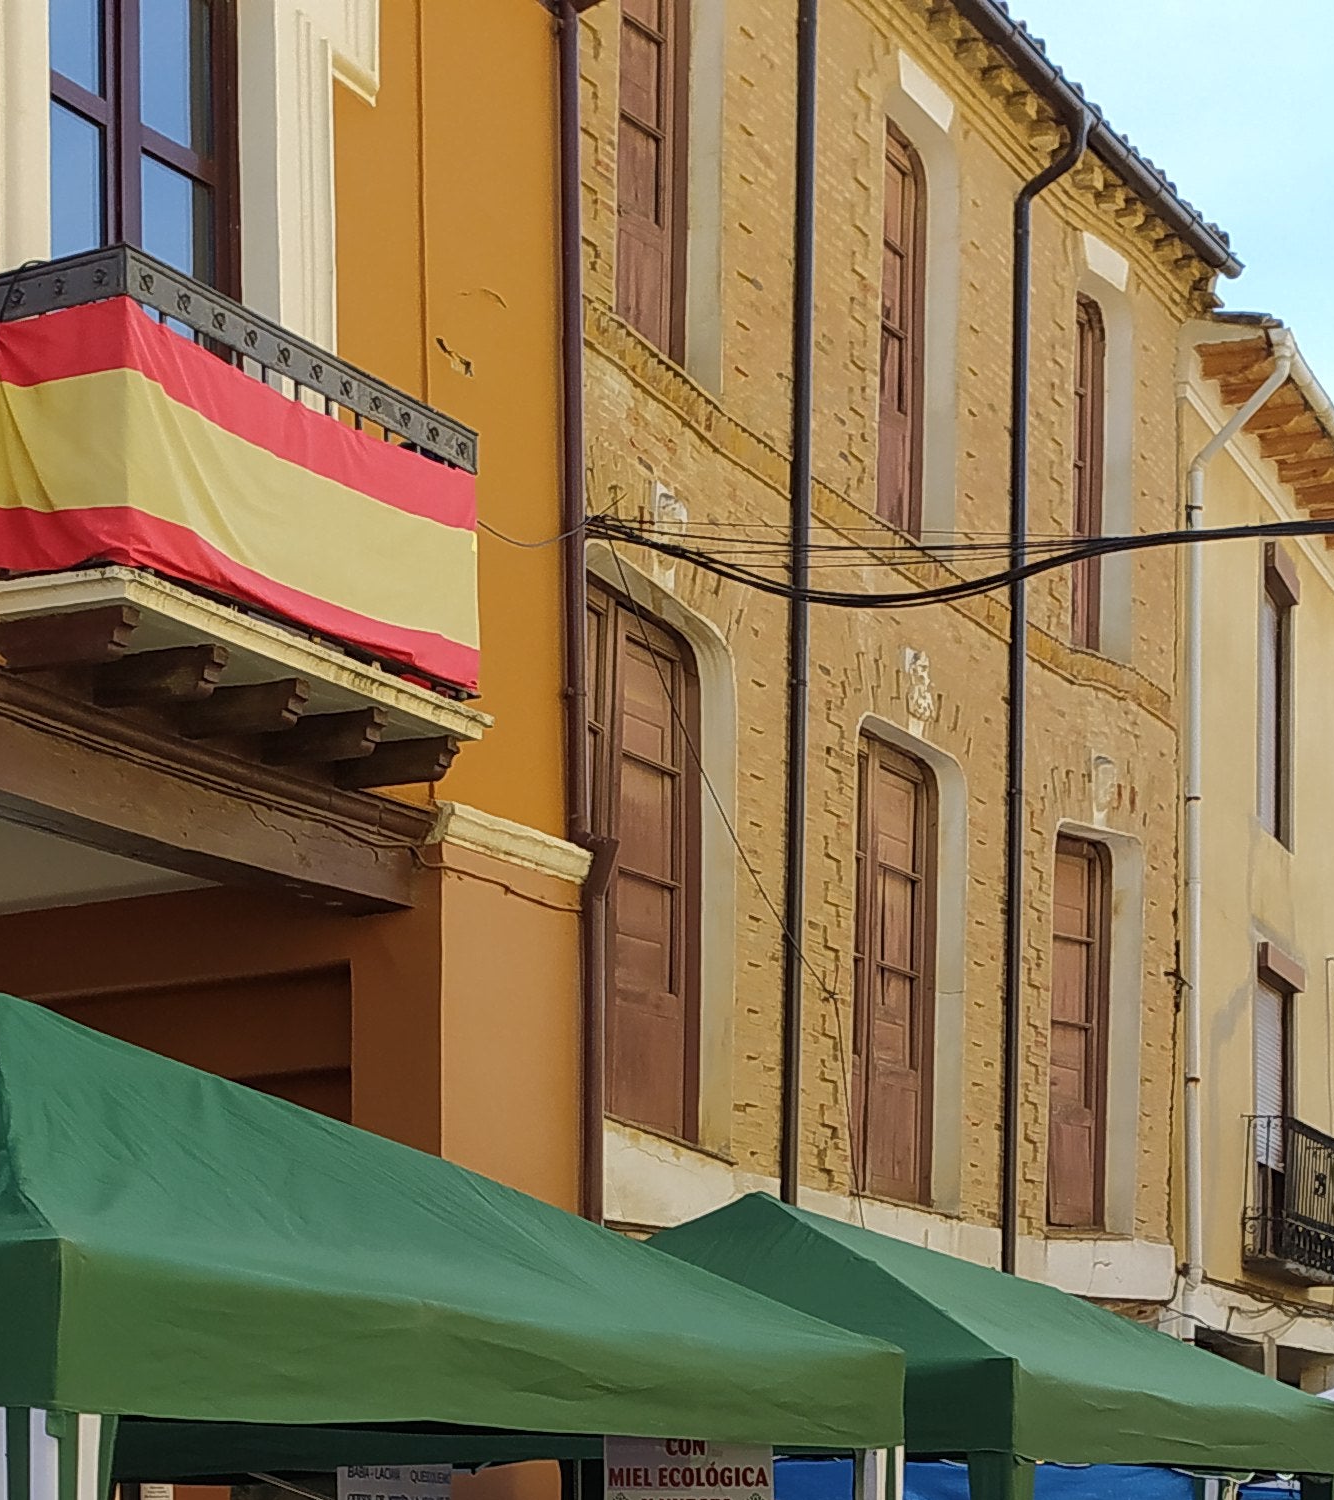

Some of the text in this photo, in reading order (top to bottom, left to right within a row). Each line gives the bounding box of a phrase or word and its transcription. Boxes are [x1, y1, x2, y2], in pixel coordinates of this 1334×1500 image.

[665, 1439, 706, 1456] CON
[608, 1461, 769, 1488] MIEL ECOLÓGICA
